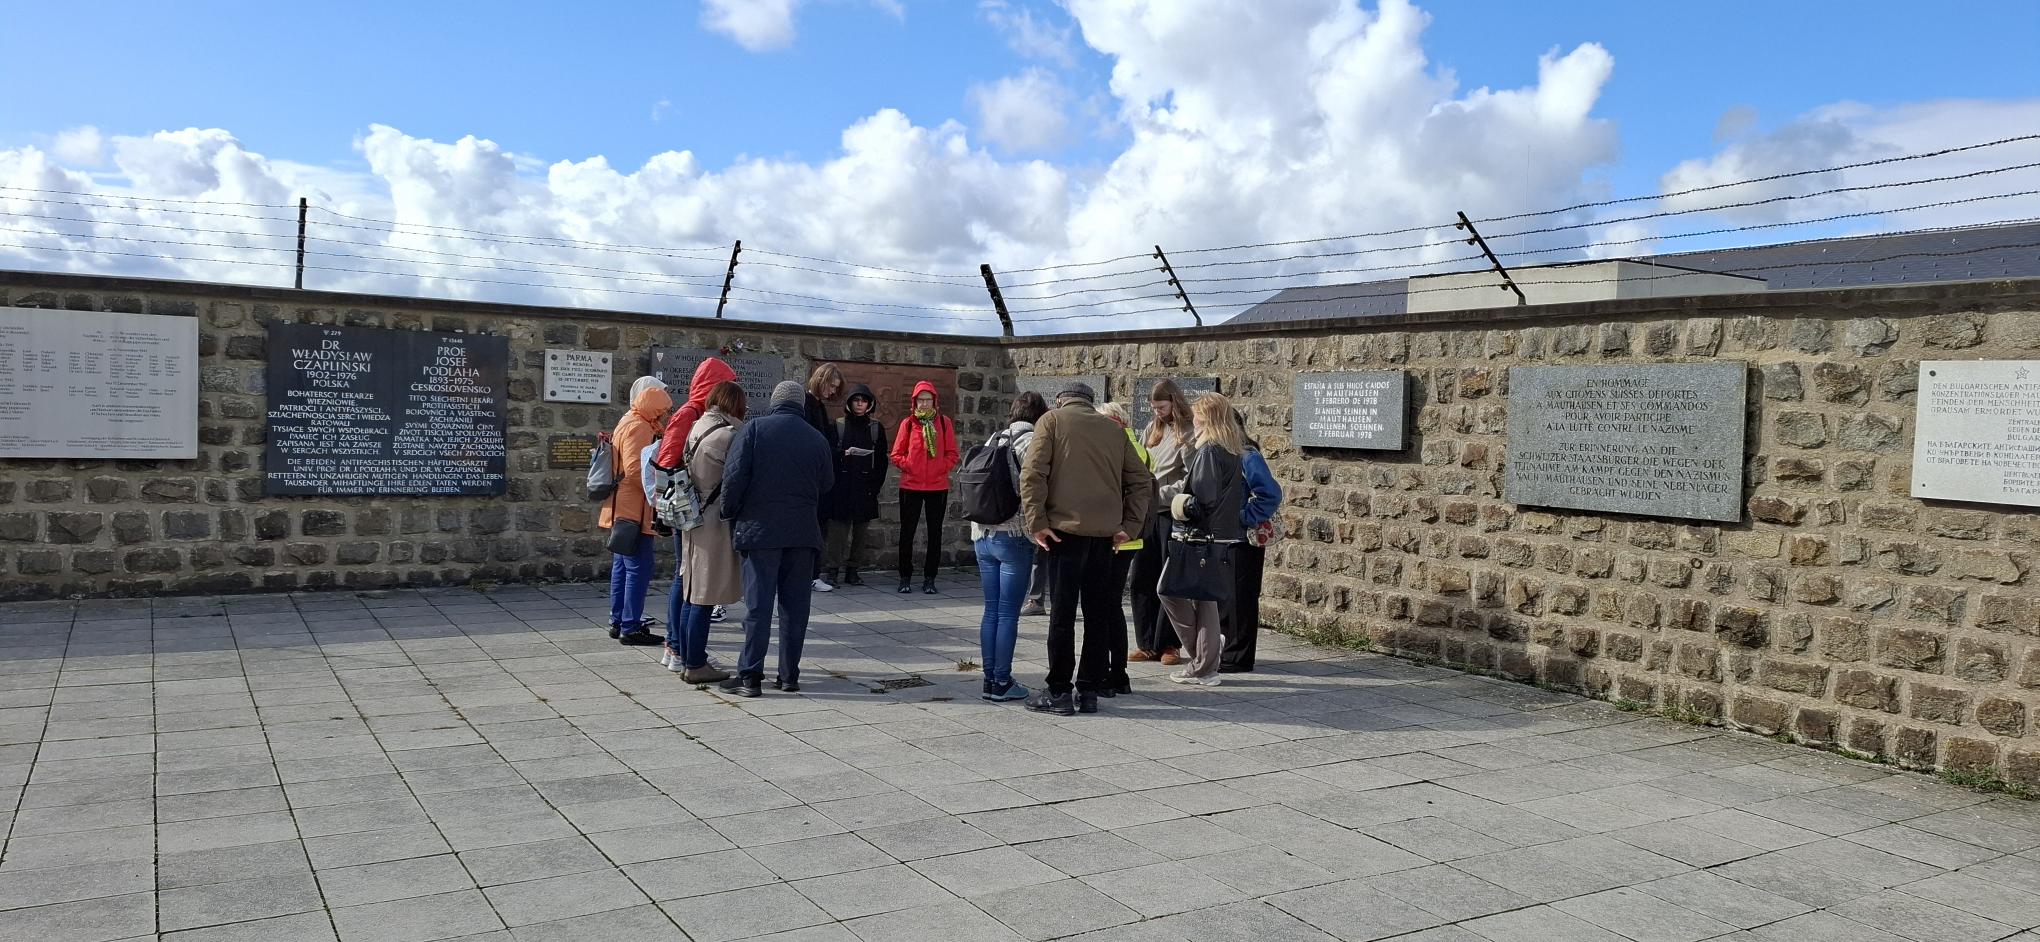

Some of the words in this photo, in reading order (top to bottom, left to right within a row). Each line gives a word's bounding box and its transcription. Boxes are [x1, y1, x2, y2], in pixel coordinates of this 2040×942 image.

[322, 340, 340, 350] DR
[292, 349, 372, 362] WŁADYSŁAW
[566, 354, 592, 362] PARMA
[434, 356, 468, 366] JOSEF
[306, 371, 356, 380] 1902-1976
[423, 366, 480, 377] PODLAHA
[314, 380, 350, 388] POLSKA
[430, 376, 474, 385] 1893-1975
[1601, 379, 1649, 387] HOMMAGE
[1346, 382, 1363, 390] HIJOS
[288, 390, 338, 398] BOHATERSCY
[1545, 390, 1562, 399] AUX
[1565, 390, 1606, 399] CITOYENS
[1610, 390, 1644, 399] SUISSES
[1547, 401, 1602, 410] MAUTHAUSEN
[1606, 402, 1617, 410] ET
[1620, 402, 1636, 410] SES
[1640, 401, 1708, 411] COMMANDOS
[1565, 412, 1589, 420] POUR
[1595, 412, 1620, 421] AVOIR
[1569, 423, 1594, 431] LUTTE
[1598, 424, 1633, 432] CONTRE
[1638, 424, 1648, 432] LE
[1651, 424, 1696, 434] NAZISME
[1559, 443, 1574, 451] ZUR
[1580, 443, 1638, 453] ERINNERUNG
[1642, 446, 1656, 454] AN
[1661, 446, 1678, 455] DIE
[1519, 452, 1566, 461] SCHWEIZER
[1642, 457, 1659, 466] DIE
[1663, 458, 1698, 467] WEGEN
[1704, 460, 1726, 470] DER
[1514, 462, 1560, 472] TEILNAHME
[1582, 466, 1616, 475] KAMPF
[1618, 467, 1649, 477] GEGEN
[1654, 469, 1673, 478] DEN
[1677, 470, 1730, 481] NAZISMUS
[1516, 472, 1539, 481] NACH
[1546, 474, 1604, 485] MAUTHAUSEN
[1609, 478, 1627, 487] UND
[1631, 480, 1658, 489] SEINE
[1664, 481, 1728, 494] NEBENLAGER
[1570, 486, 1615, 497] GEBRACHT
